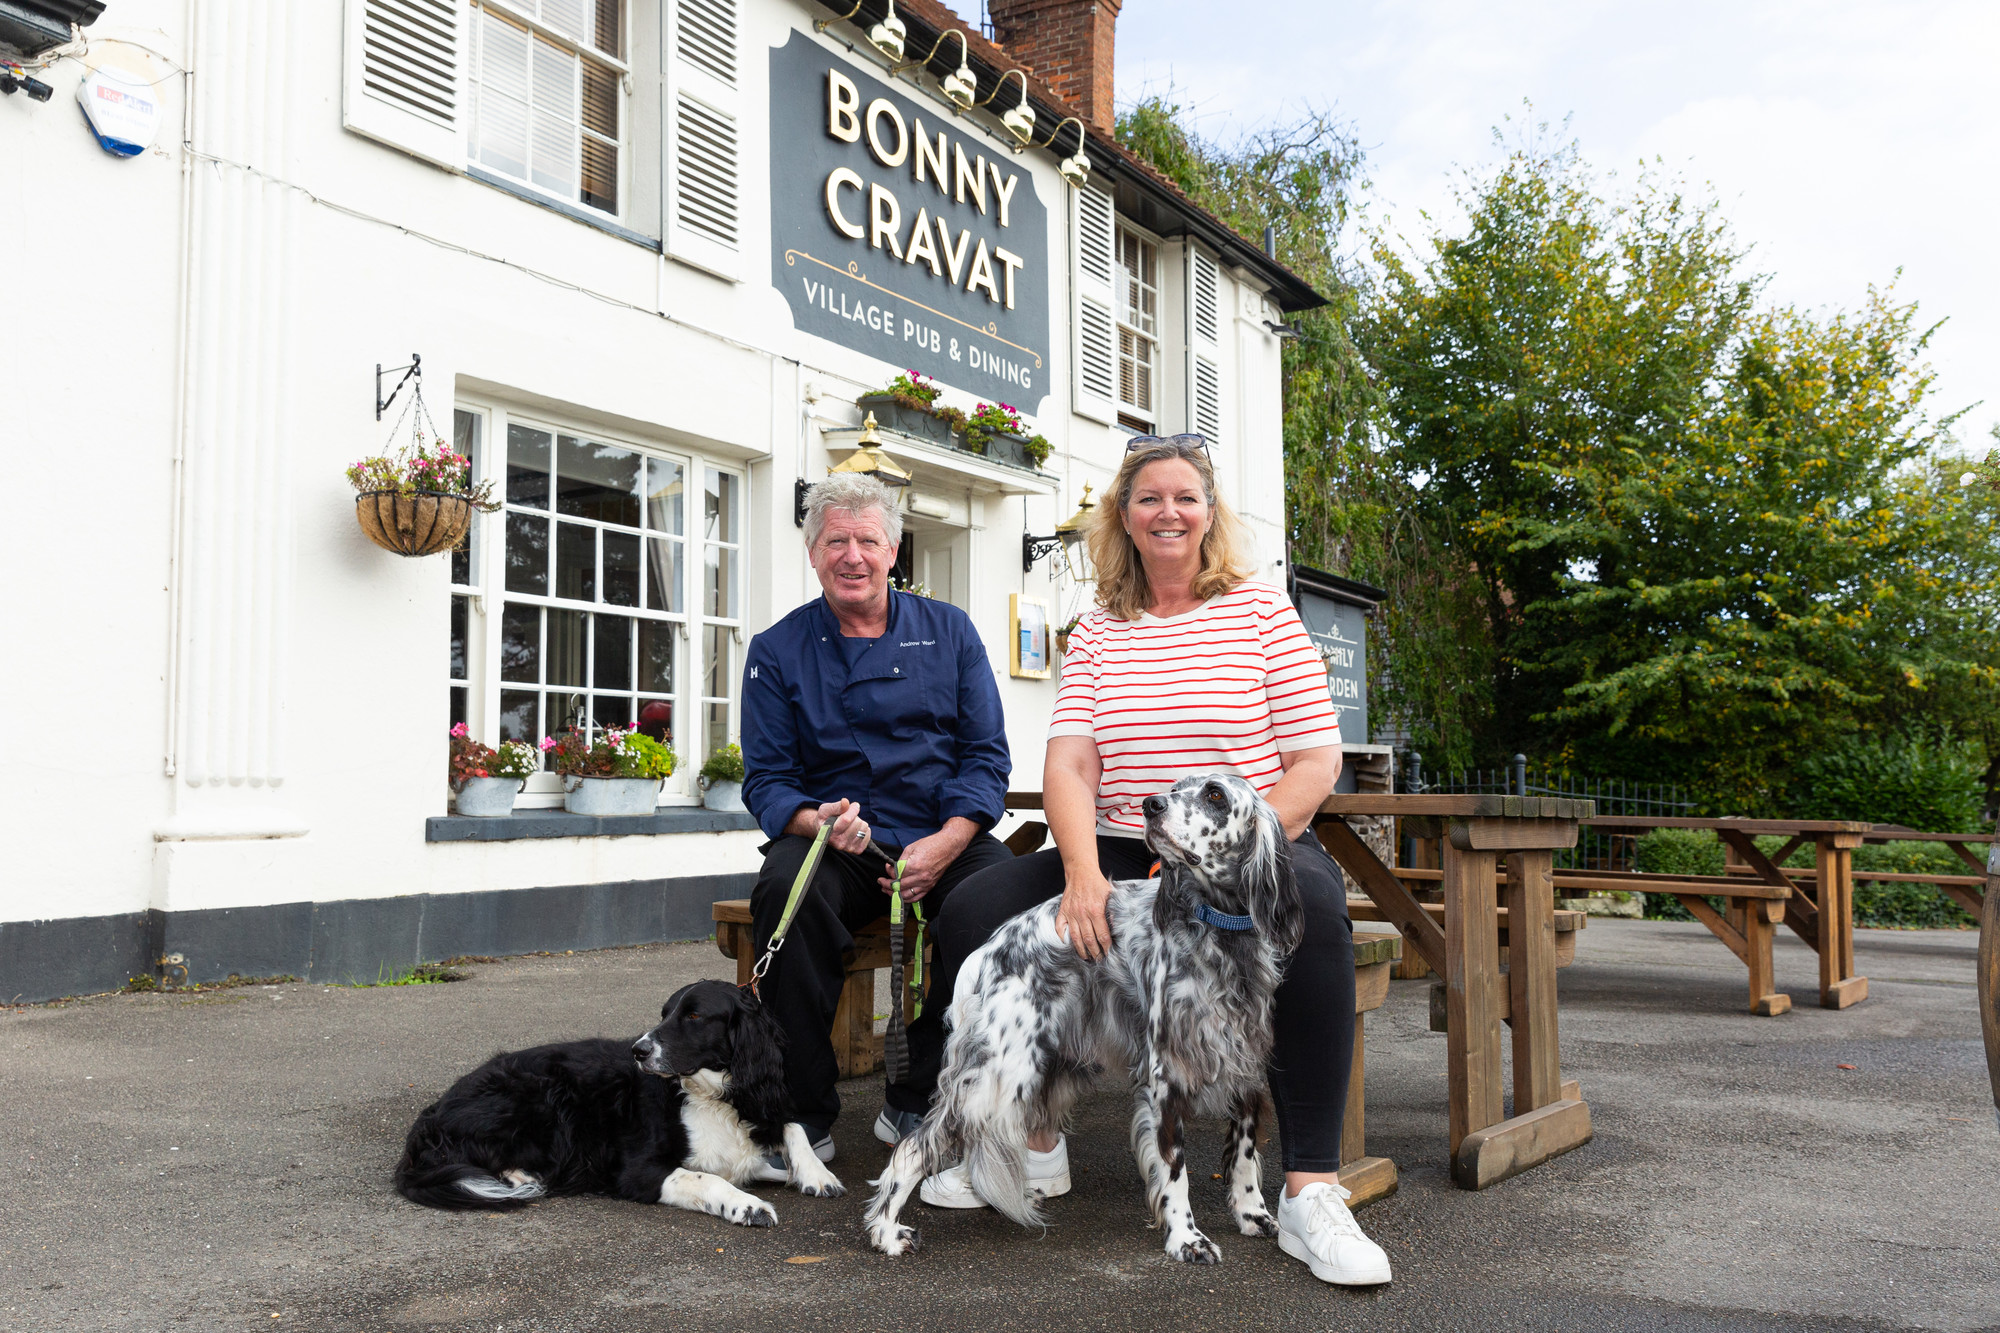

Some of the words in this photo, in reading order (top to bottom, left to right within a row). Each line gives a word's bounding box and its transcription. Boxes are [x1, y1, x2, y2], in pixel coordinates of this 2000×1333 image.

[828, 68, 1018, 228] BONNY
[825, 167, 1024, 310] CRAVAT
[802, 277, 895, 336] VILLAGE
[903, 318, 941, 353] PUB
[949, 337, 962, 363] &
[969, 345, 1032, 389] DINING
[1329, 676, 1359, 699] RDEN
